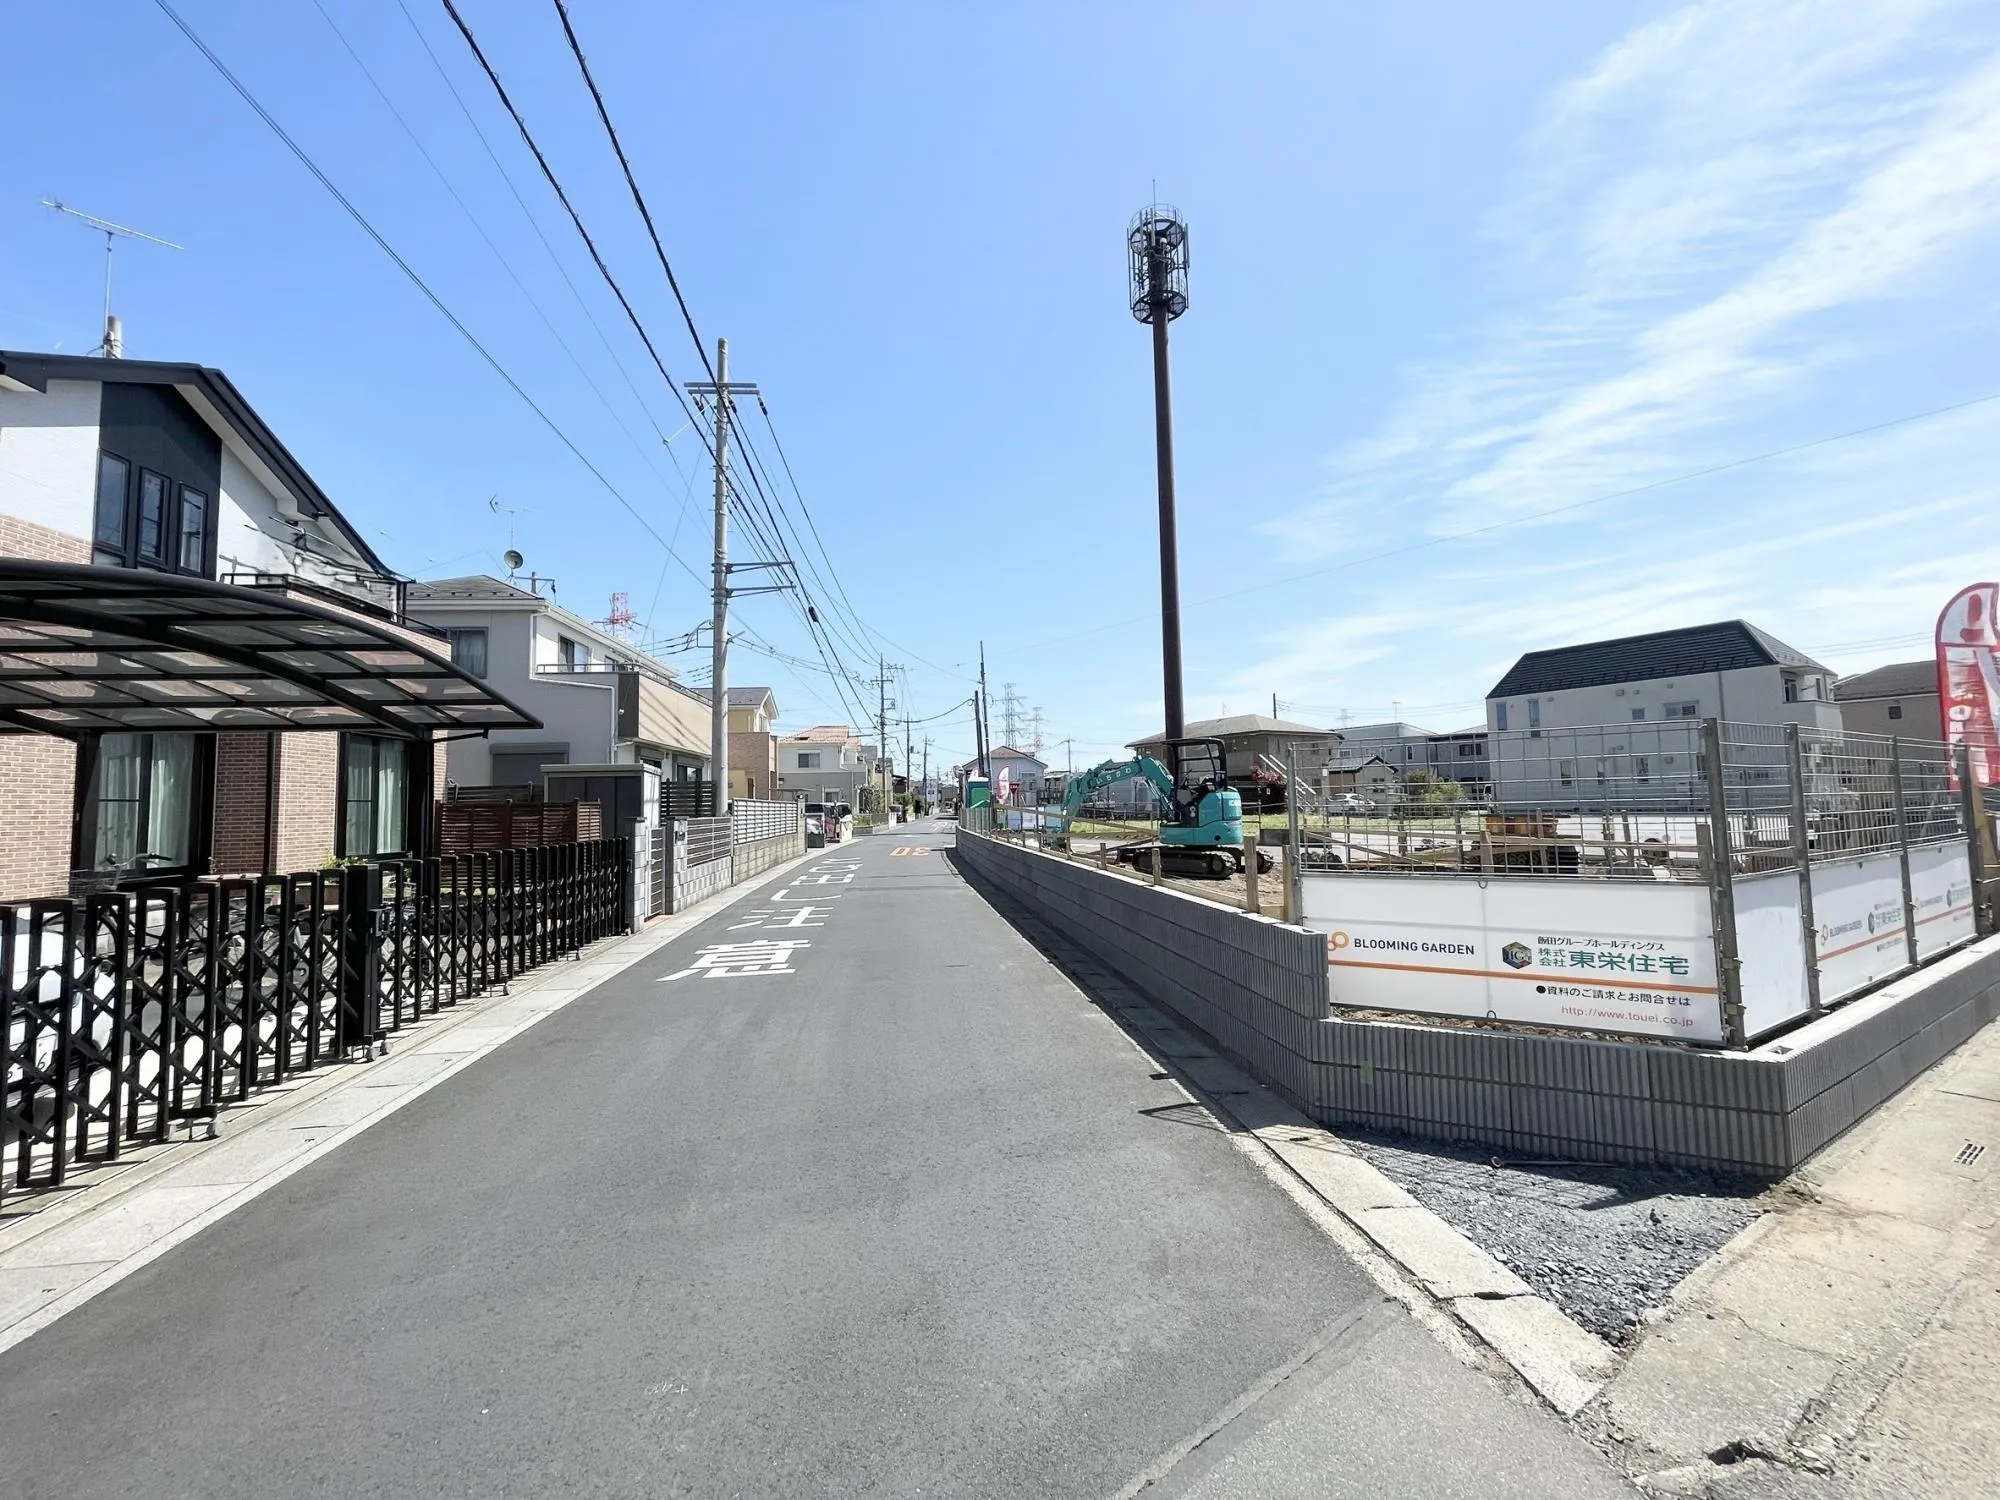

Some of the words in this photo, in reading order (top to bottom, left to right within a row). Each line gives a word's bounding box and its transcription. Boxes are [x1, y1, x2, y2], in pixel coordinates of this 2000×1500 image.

[1354, 938, 1418, 951] BLOOMING
[1421, 942, 1475, 955] GARDEN
[1537, 935, 1665, 951] 飯田グループホールディングス
[1569, 950, 1689, 975] 東栄住宅
[1561, 1005, 1694, 1027] http://www.touei.co.jp
